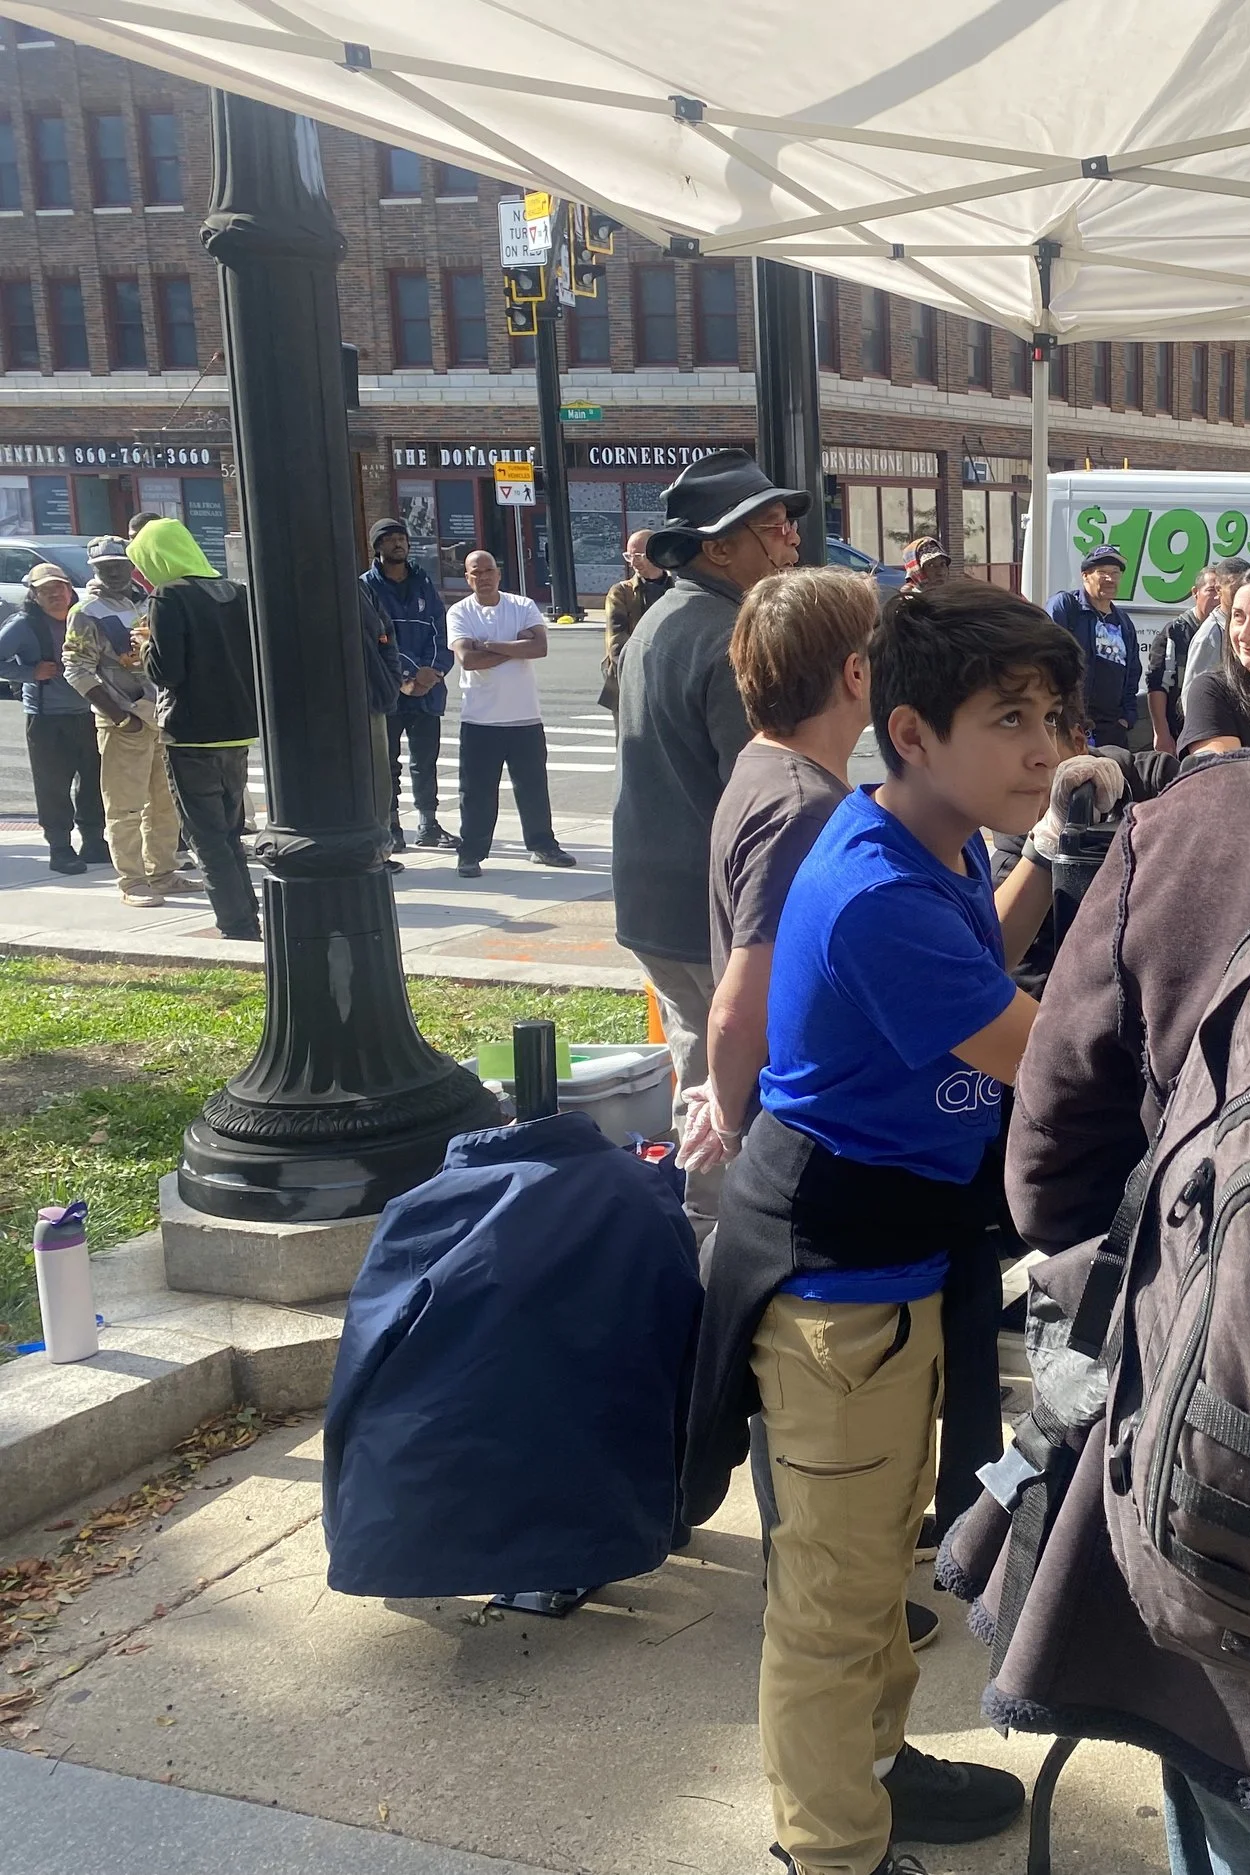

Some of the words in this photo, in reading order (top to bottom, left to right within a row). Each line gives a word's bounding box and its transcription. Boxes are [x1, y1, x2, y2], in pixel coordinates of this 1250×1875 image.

[509, 227, 528, 239] TUR
[505, 246, 518, 257] ON
[567, 409, 586, 419] Main
[394, 449, 427, 466] THE
[821, 450, 904, 472] ORNERSTONE
